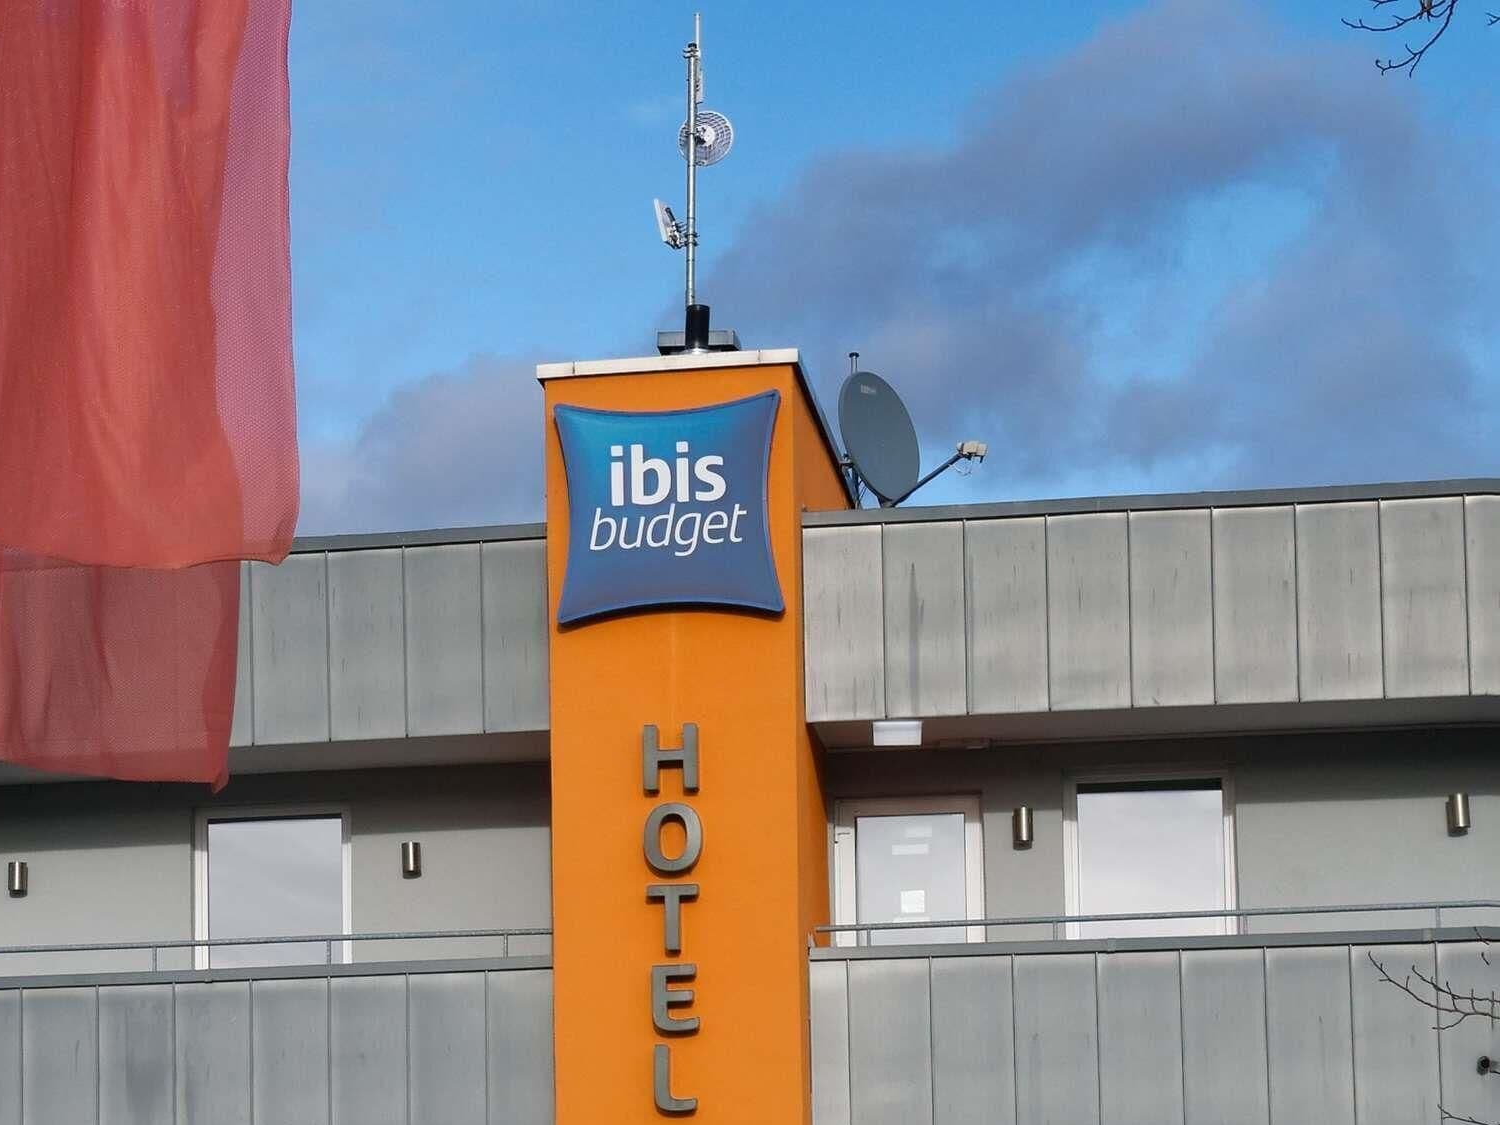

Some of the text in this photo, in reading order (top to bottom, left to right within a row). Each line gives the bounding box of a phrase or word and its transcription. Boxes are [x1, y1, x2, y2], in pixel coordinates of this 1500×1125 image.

[610, 441, 727, 507] ibis
[589, 503, 747, 556] budget
[642, 723, 703, 1115] HOTEL
